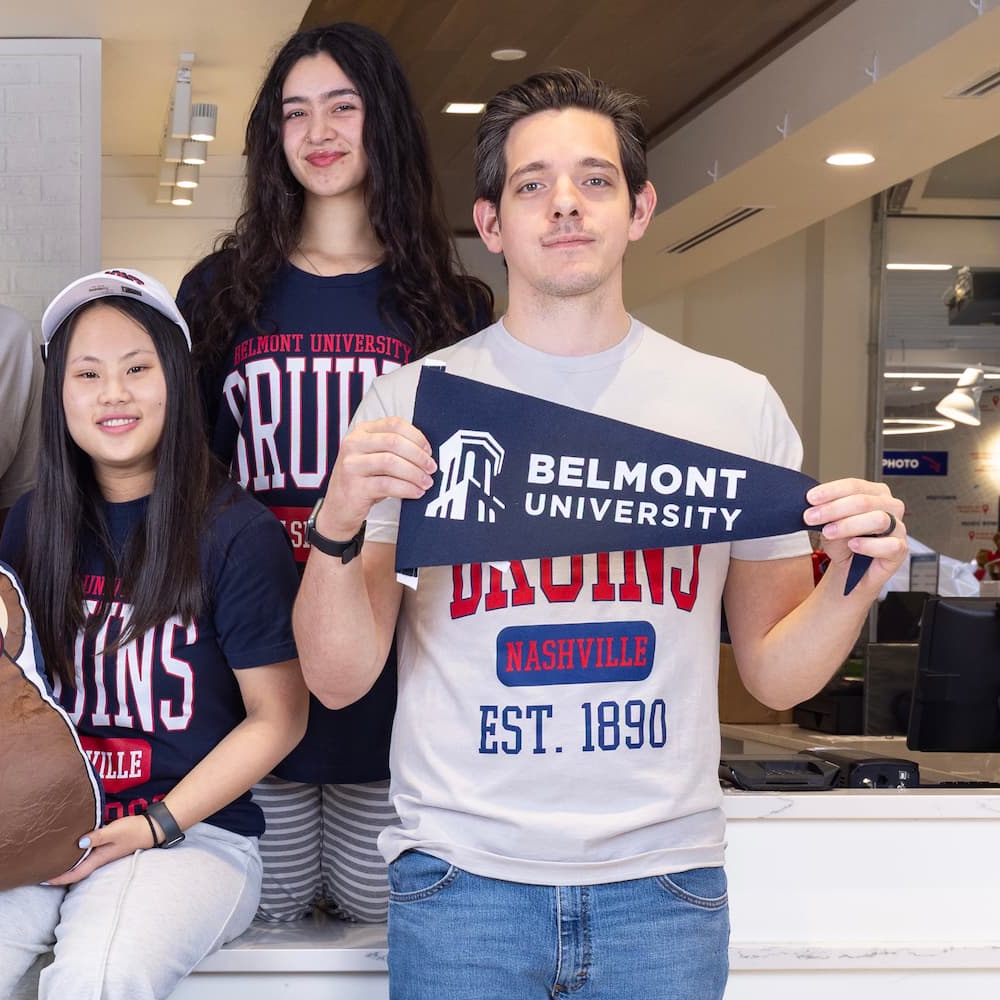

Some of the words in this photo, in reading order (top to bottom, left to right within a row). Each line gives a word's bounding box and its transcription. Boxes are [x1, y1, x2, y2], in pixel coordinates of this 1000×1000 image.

[234, 333, 303, 365] BELMONT
[310, 333, 413, 364] UNIVERSITY
[527, 452, 747, 500] BELMONT
[525, 491, 742, 532] UNIVERSITY
[505, 635, 649, 673] NASHVILLE
[478, 704, 562, 754] EST.
[581, 698, 667, 752] 1890
